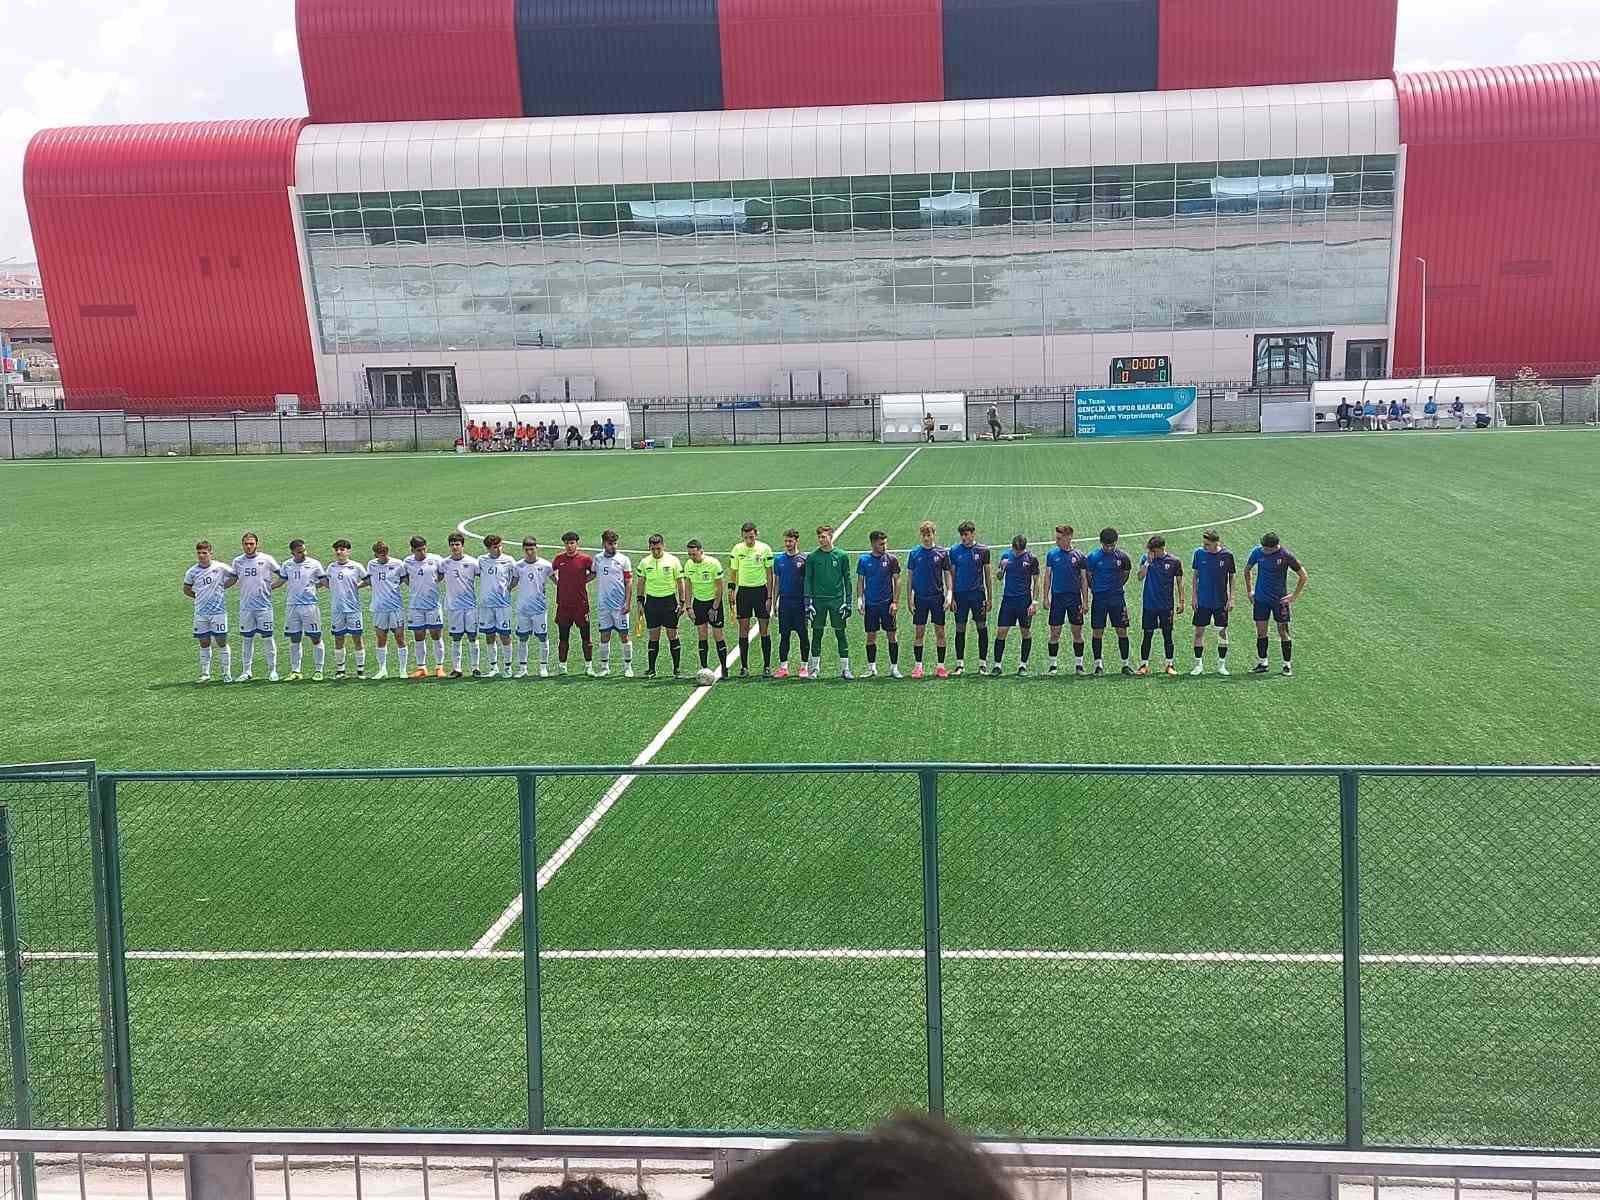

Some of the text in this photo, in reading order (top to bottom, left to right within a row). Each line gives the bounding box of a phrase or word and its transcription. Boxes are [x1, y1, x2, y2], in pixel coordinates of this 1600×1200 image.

[1116, 360, 1124, 369] A
[1158, 358, 1165, 367] B
[1121, 371, 1129, 382] 0
[244, 567, 257, 577] 58
[294, 570, 301, 580] 11
[417, 567, 424, 576] 4
[487, 566, 498, 576] 61
[603, 566, 609, 576] 5
[202, 576, 212, 585] 10
[527, 572, 534, 582] 9
[216, 623, 226, 632] 10
